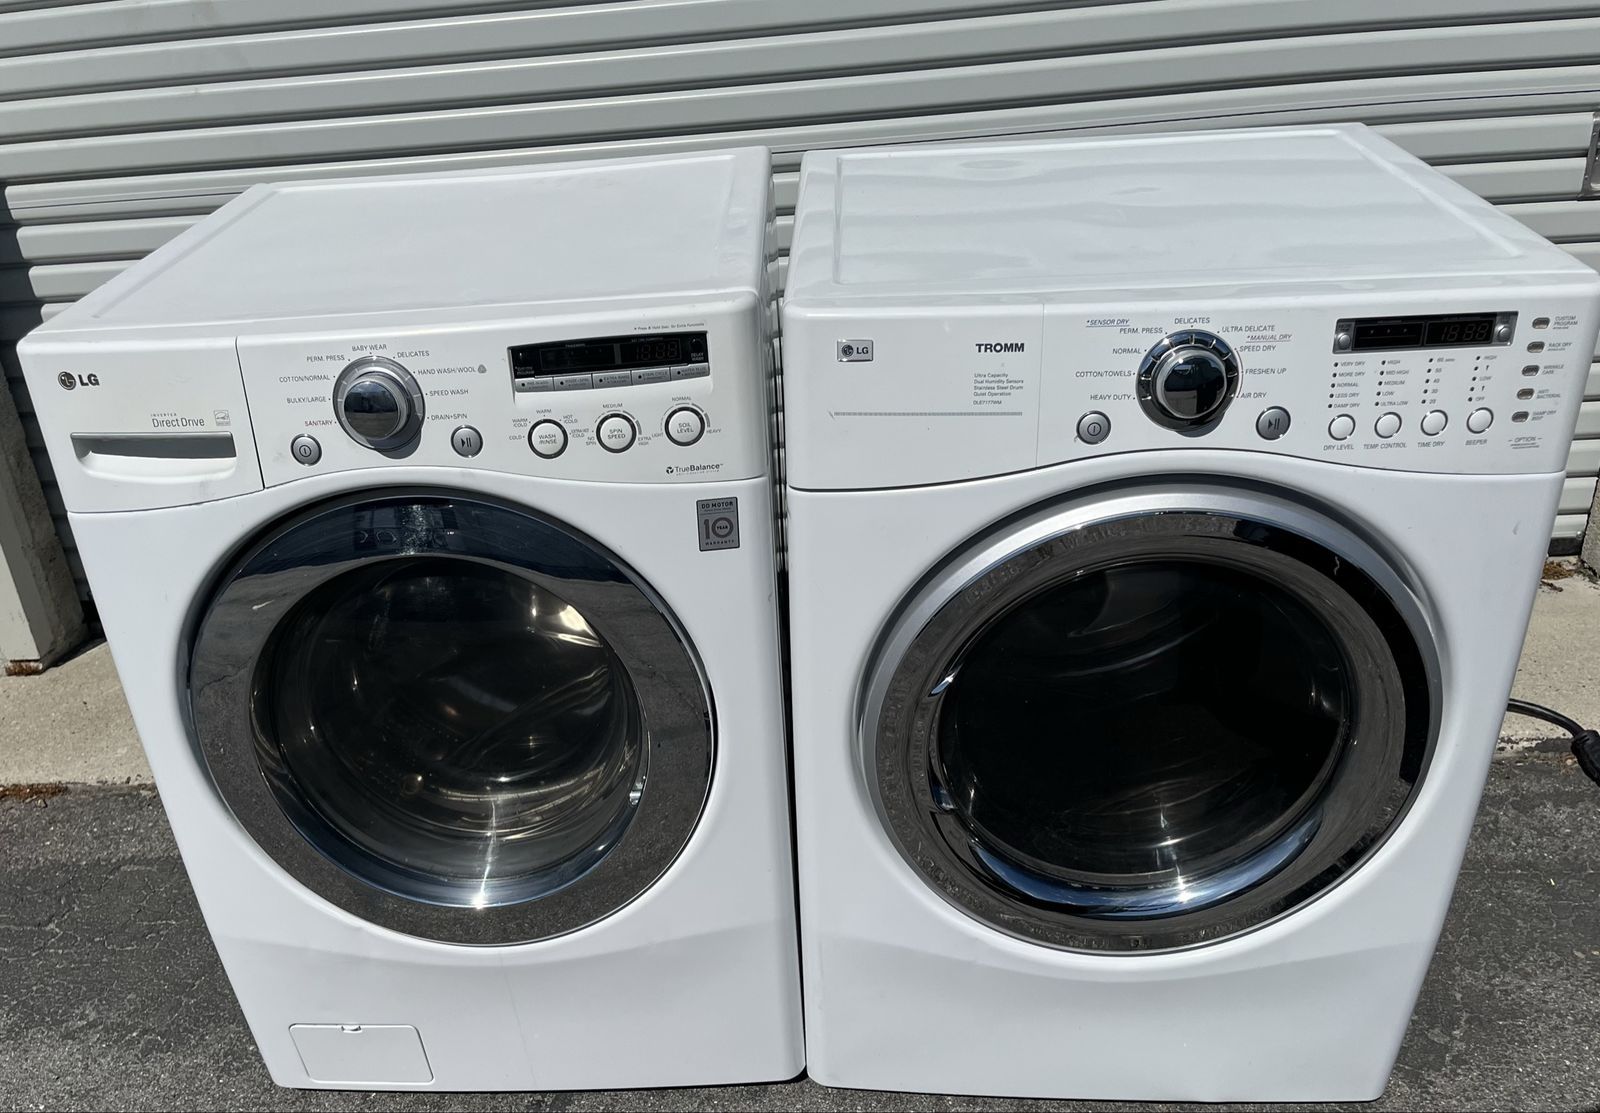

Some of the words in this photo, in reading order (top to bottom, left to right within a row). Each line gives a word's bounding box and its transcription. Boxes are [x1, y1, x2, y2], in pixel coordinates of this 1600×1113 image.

[976, 342, 1024, 353] TROMM
[78, 374, 100, 387] LG
[279, 375, 330, 383] COTTON/NORMAL
[152, 418, 180, 428] Direct
[181, 418, 205, 426] Drive
[704, 517, 733, 540] 10
